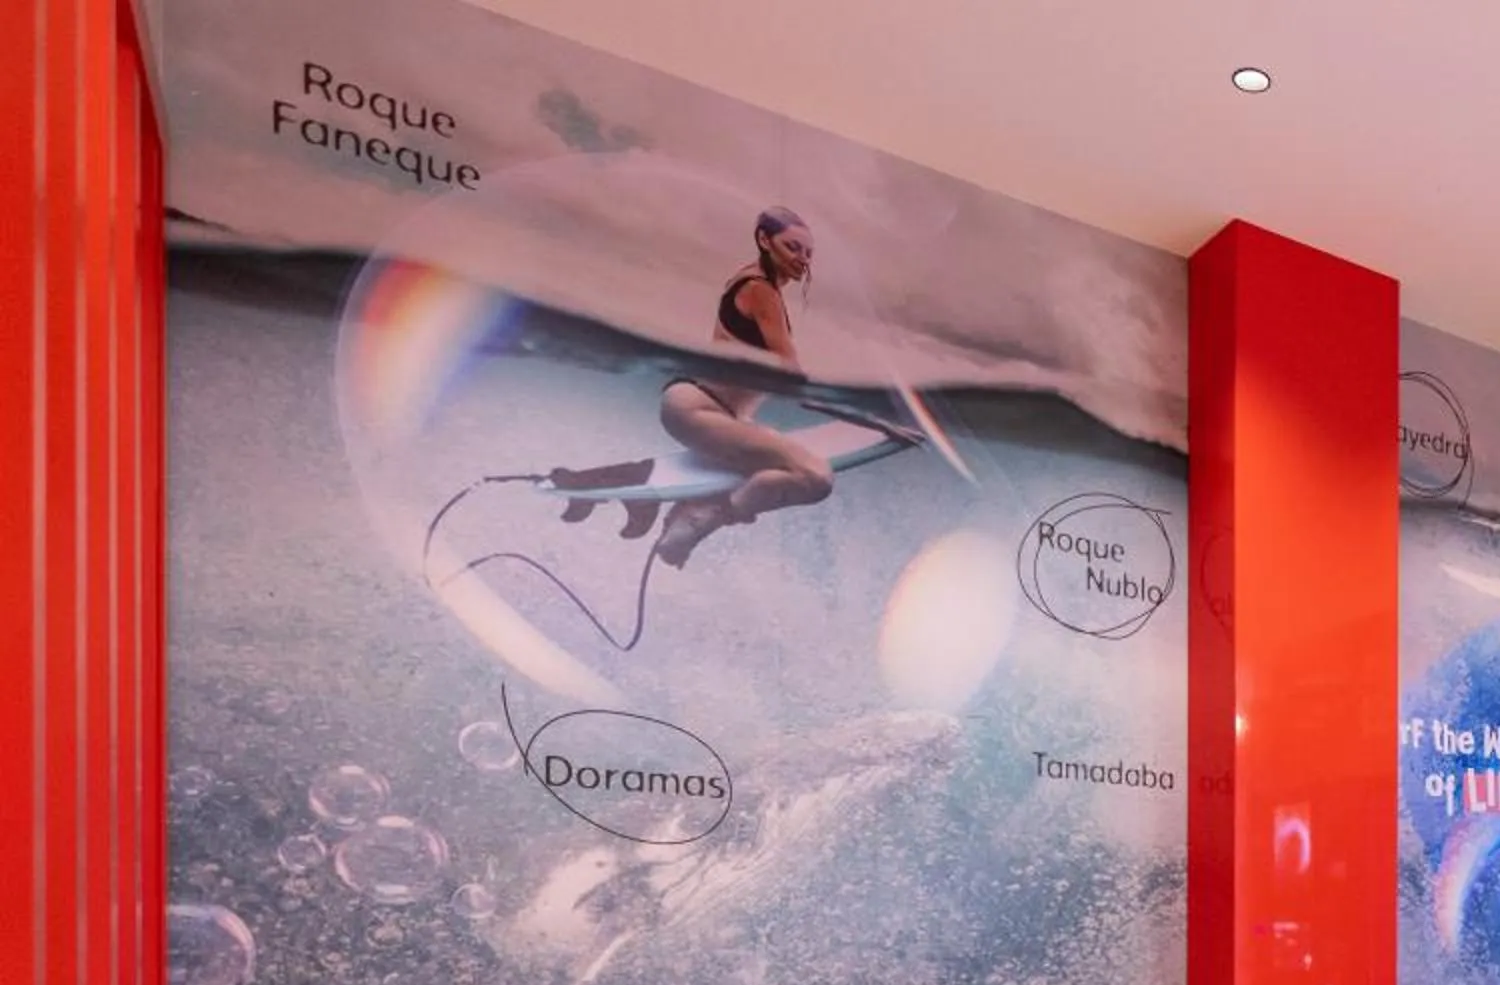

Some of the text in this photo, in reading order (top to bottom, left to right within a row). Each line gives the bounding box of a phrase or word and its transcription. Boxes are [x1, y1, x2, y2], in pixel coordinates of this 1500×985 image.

[303, 62, 456, 138] Roque
[272, 100, 480, 190] Faneque
[1399, 424, 1468, 459] ayedra
[1039, 521, 1125, 563] Roque
[1086, 566, 1163, 605] Nublo
[1433, 719, 1475, 755] the
[545, 755, 725, 799] Doramas
[1033, 751, 1174, 790] Tamadaba
[1425, 774, 1455, 817] of
